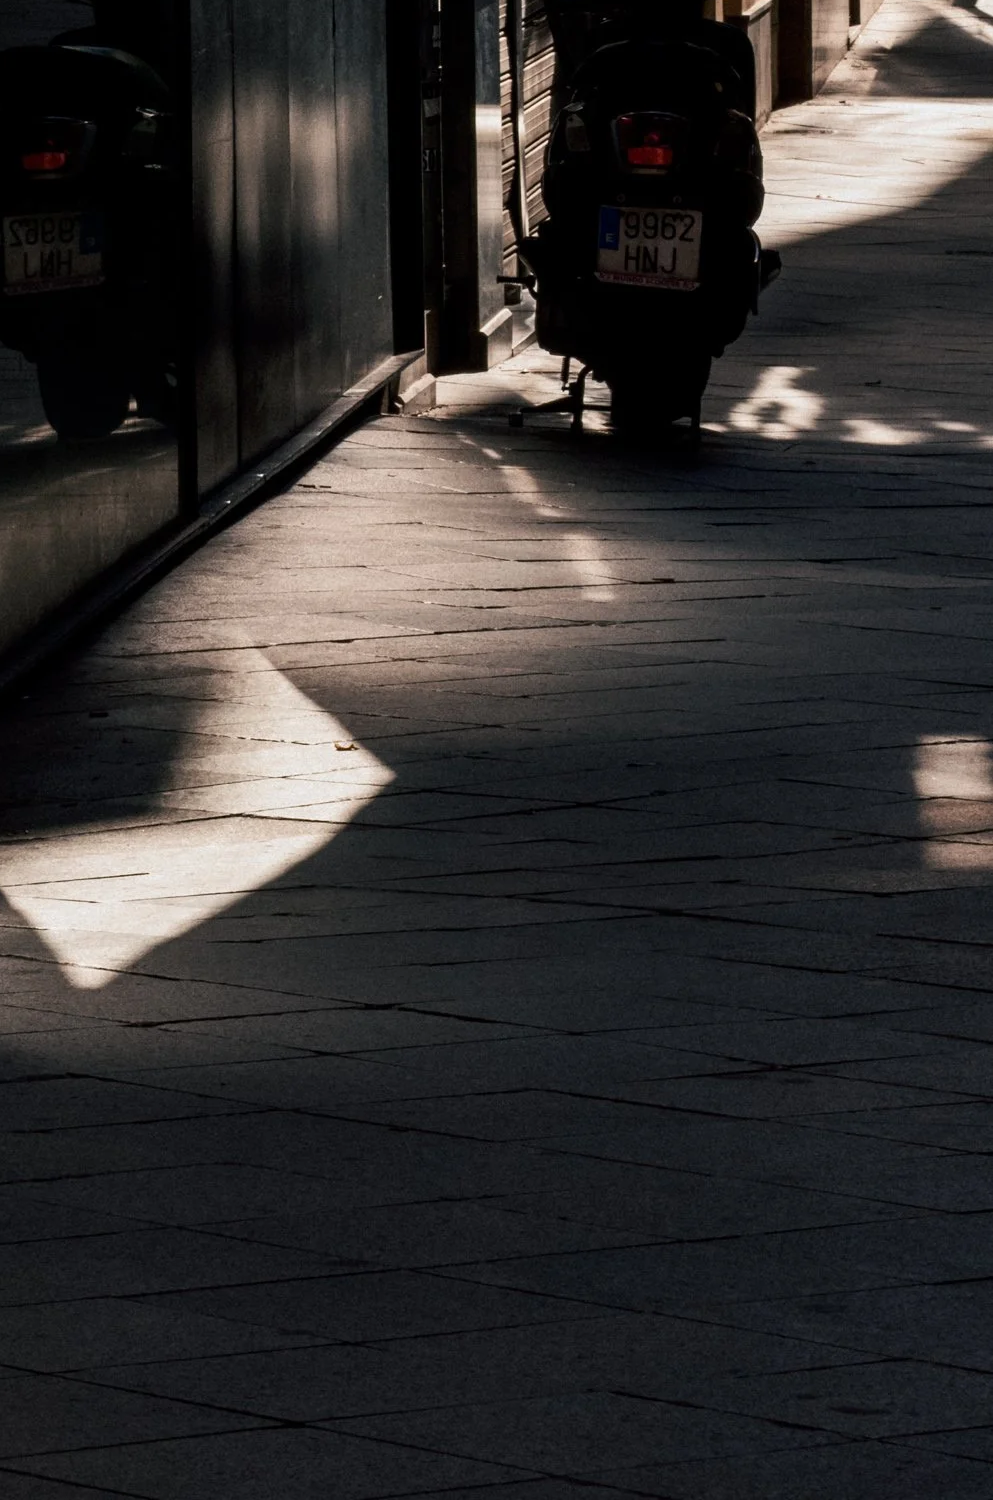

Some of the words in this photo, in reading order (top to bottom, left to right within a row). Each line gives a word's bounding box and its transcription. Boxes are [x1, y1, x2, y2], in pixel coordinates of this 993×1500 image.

[605, 232, 617, 243] E
[624, 212, 695, 242] 9962
[624, 245, 677, 273] HNJ
